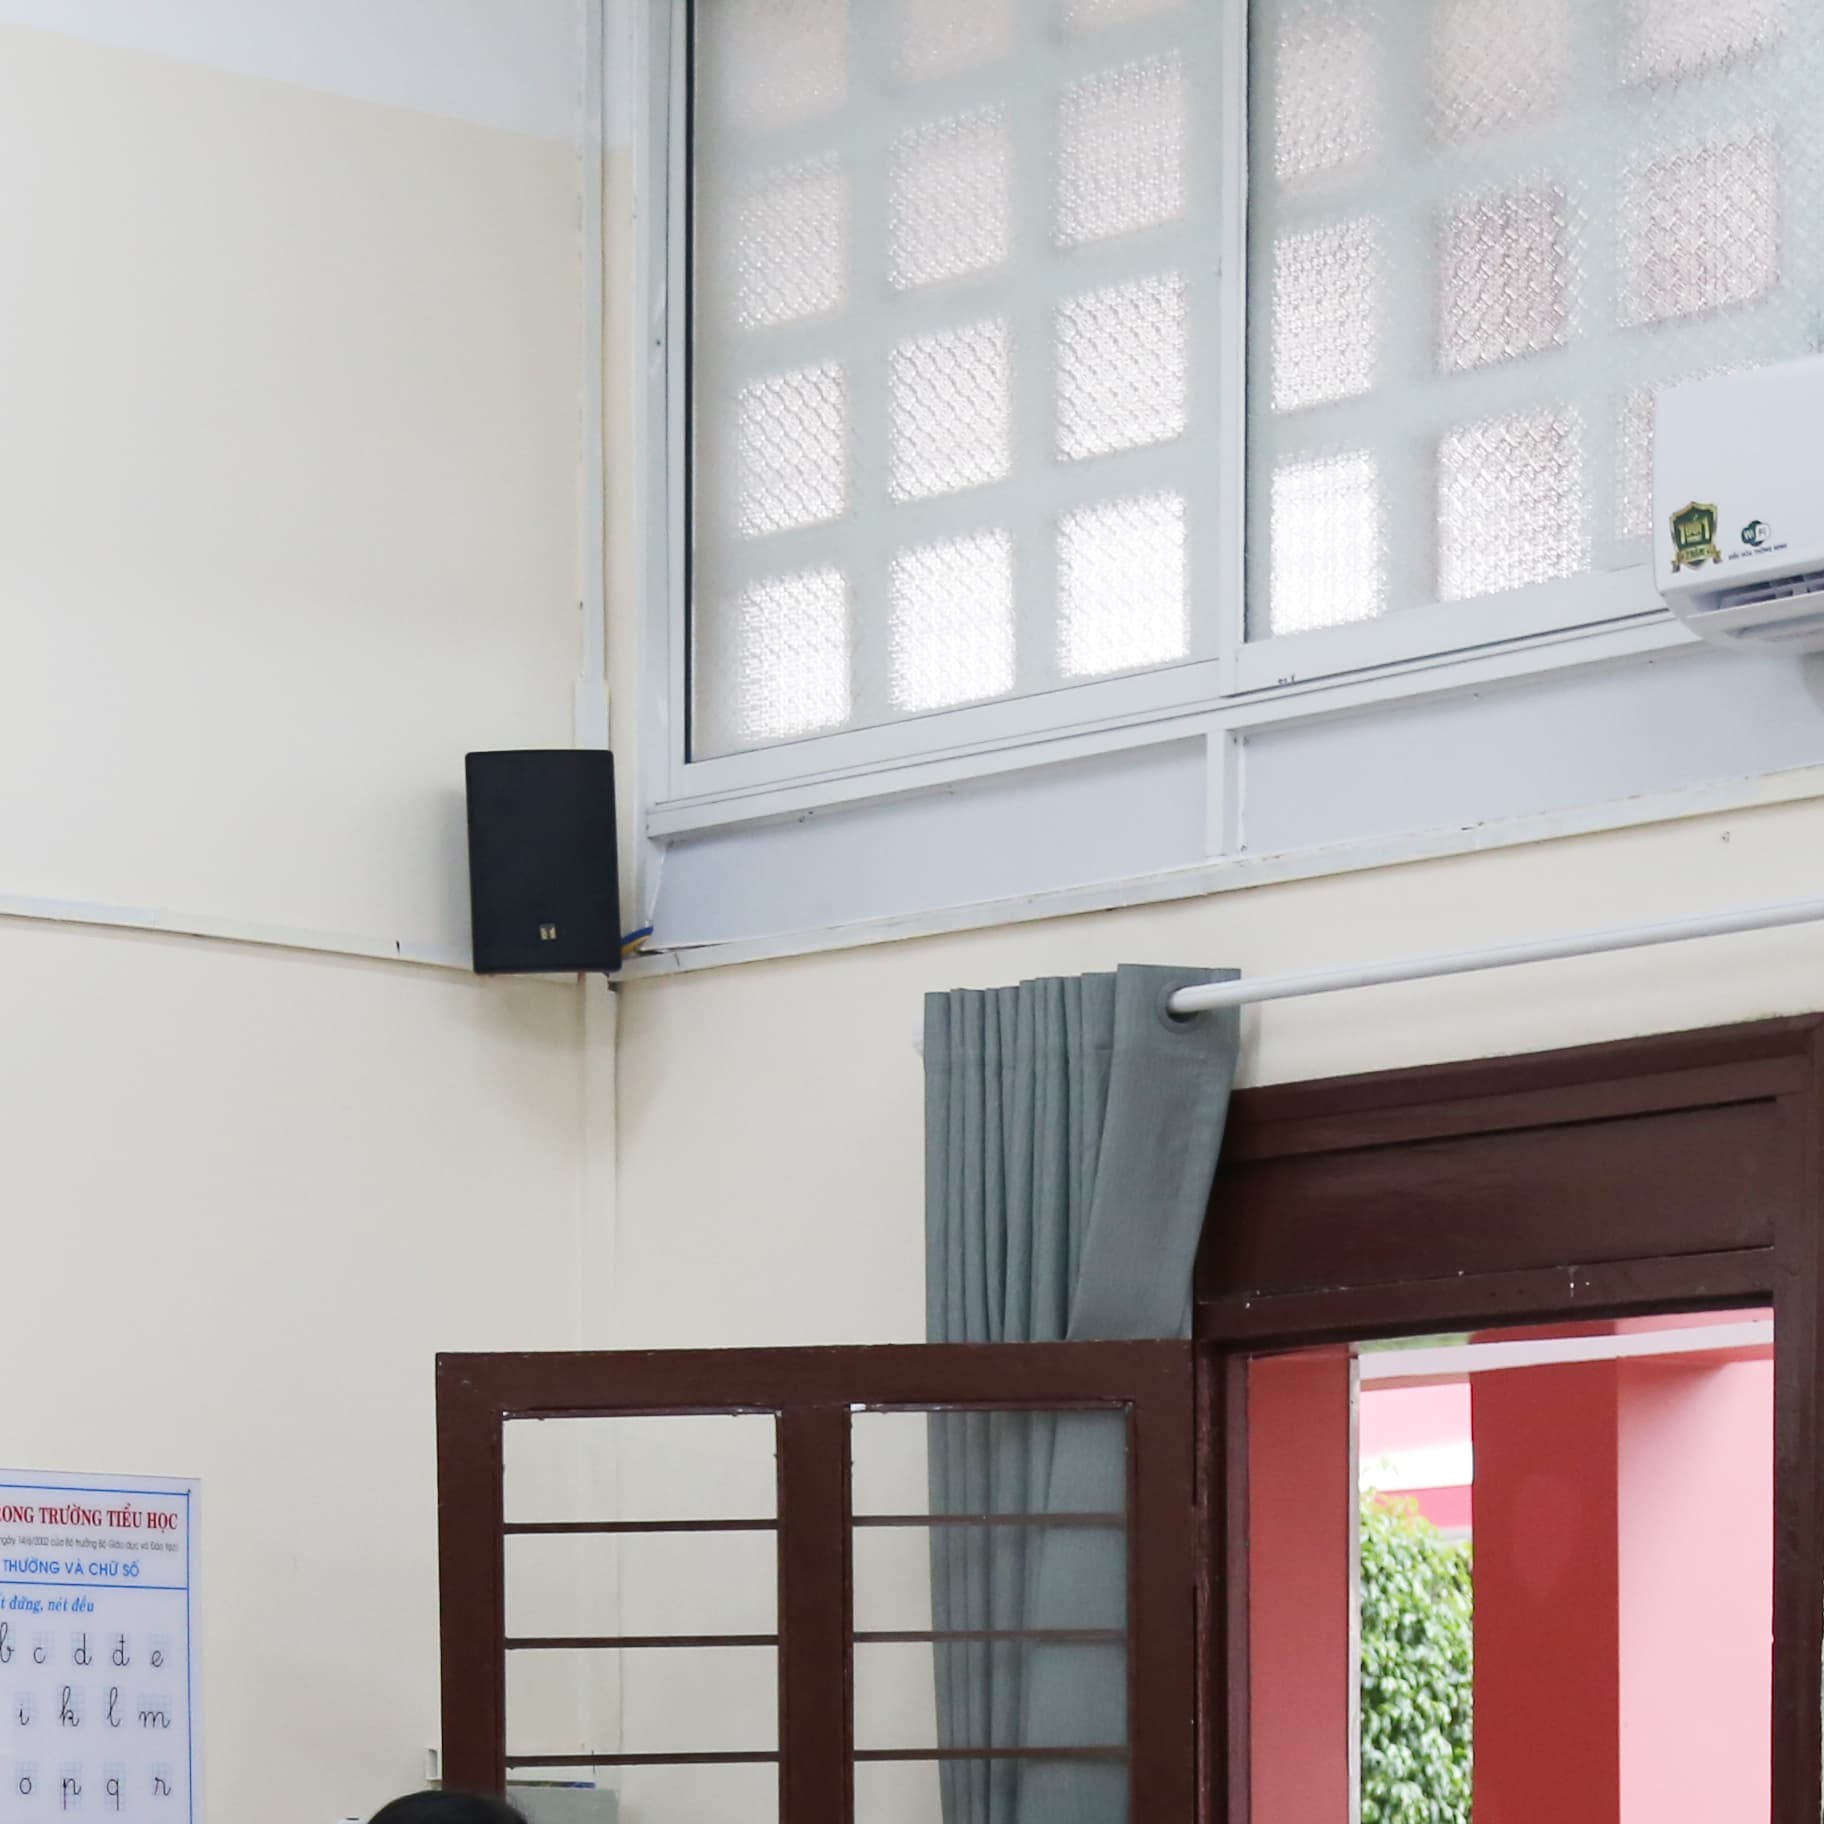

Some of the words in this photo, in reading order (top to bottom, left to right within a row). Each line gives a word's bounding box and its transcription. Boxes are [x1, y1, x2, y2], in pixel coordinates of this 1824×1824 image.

[38, 1503, 103, 1527] TRƯỜNG
[106, 1502, 143, 1529] TIỂU
[146, 1512, 178, 1534] HỌC
[88, 1560, 119, 1577] CHỮ
[32, 1646, 47, 1665] c
[73, 1632, 93, 1666] d
[111, 1632, 131, 1667] đ
[150, 1648, 164, 1668] e
